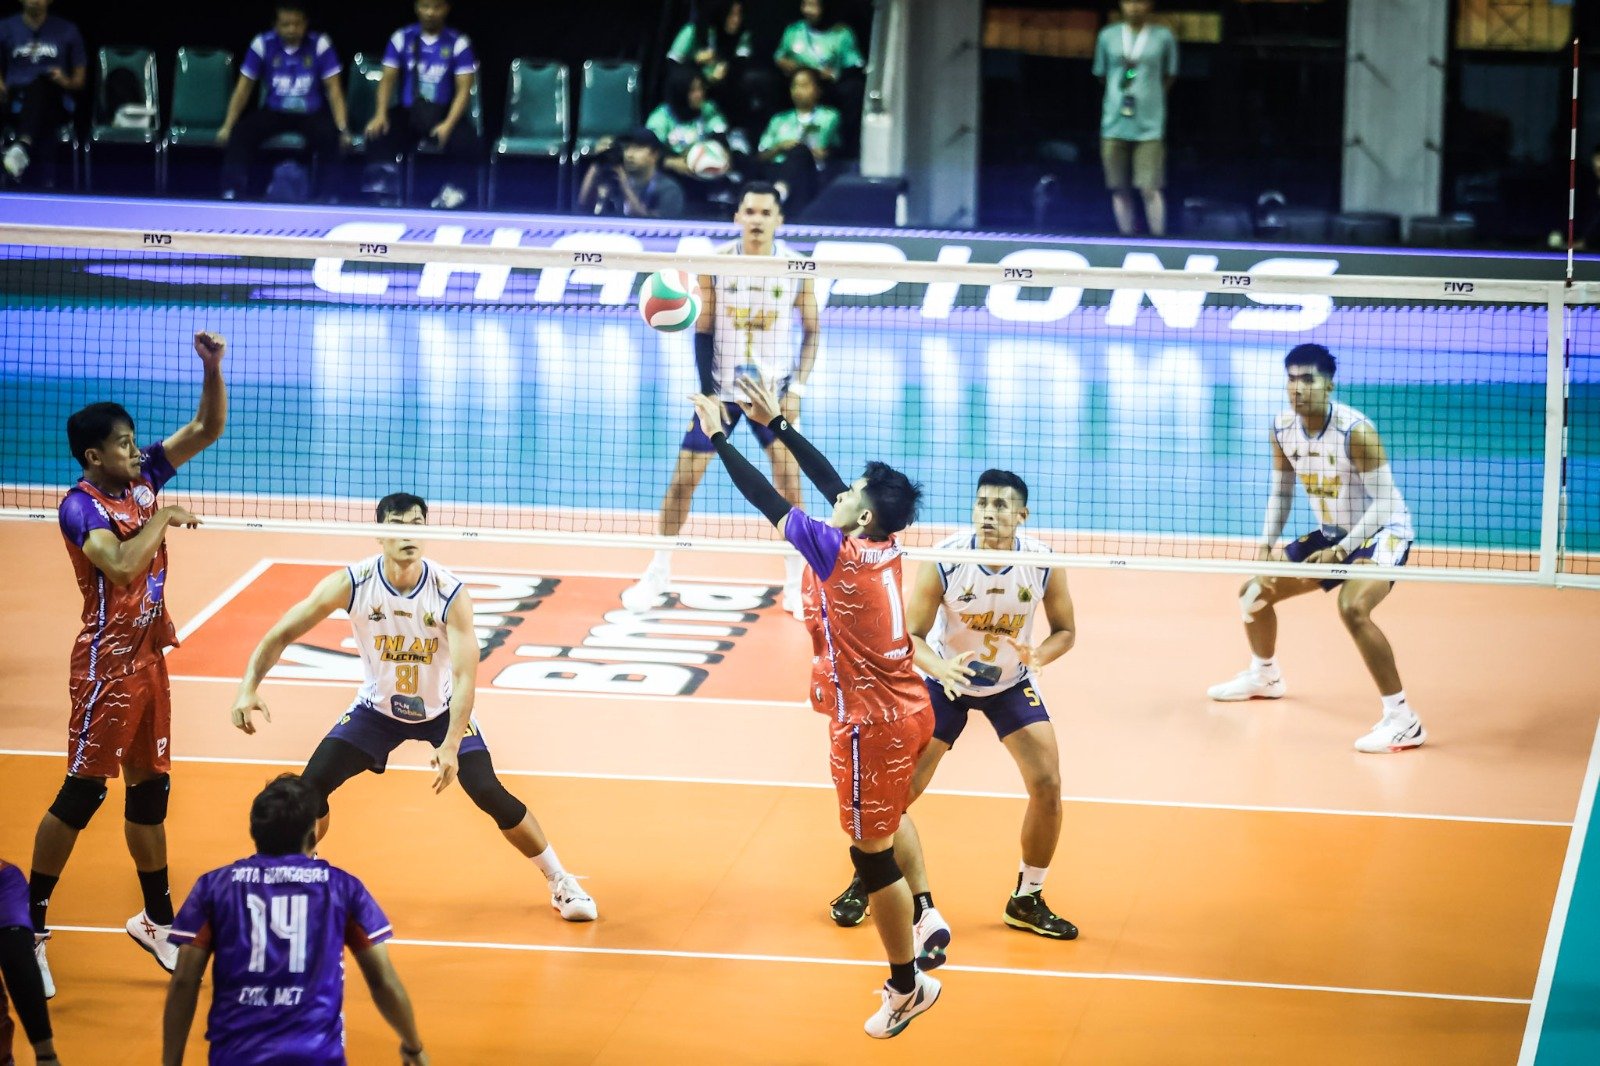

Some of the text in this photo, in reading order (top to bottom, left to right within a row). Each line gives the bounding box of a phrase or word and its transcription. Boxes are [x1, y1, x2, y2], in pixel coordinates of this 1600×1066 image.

[882, 567, 904, 641] 1
[959, 610, 1028, 629] TNI AU
[374, 634, 439, 654] TNI AU
[491, 585, 783, 696] Bima
[980, 633, 1000, 663] 5
[396, 664, 419, 694] 81
[1023, 686, 1042, 707] 5
[246, 893, 309, 974] 14
